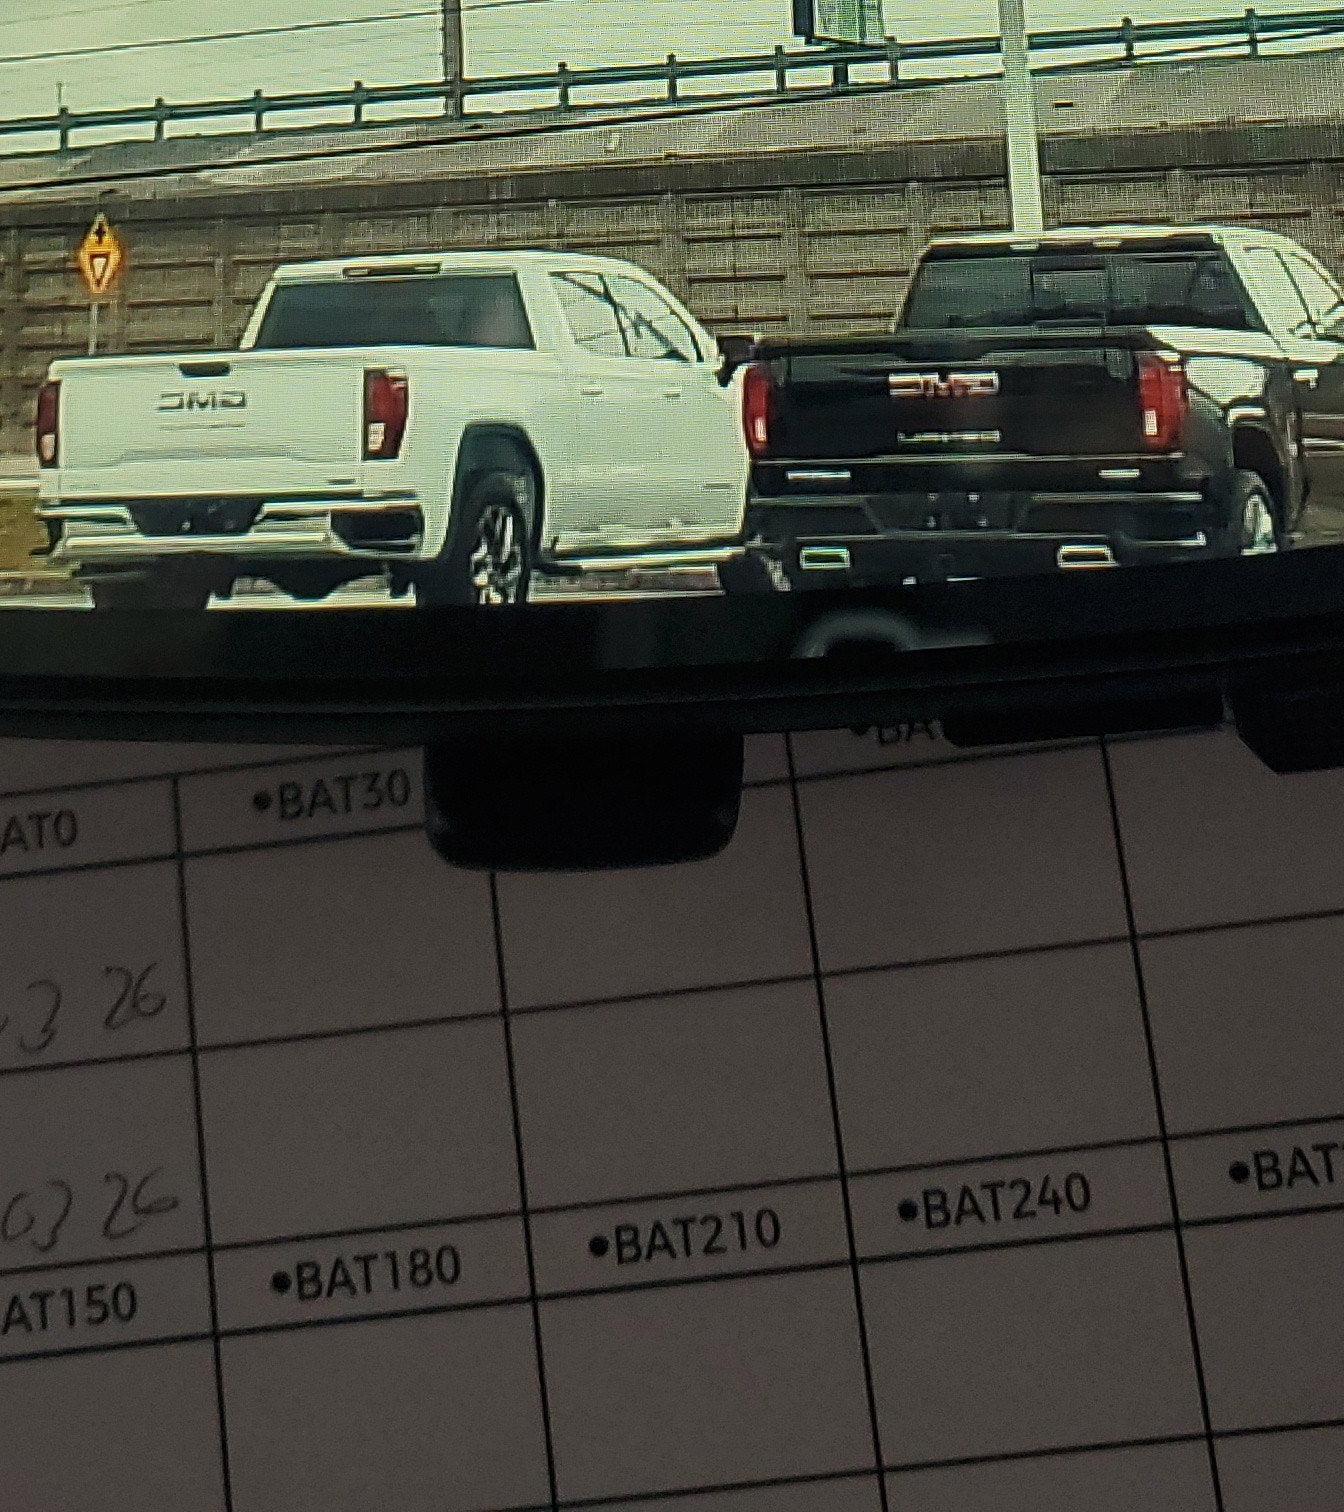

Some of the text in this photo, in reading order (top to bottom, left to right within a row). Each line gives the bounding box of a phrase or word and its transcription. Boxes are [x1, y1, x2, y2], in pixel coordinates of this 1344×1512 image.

[277, 768, 411, 821] BAT30
[105, 962, 167, 1031] 26
[103, 1165, 180, 1239] 26
[922, 1171, 1092, 1230] BAT240
[614, 1208, 782, 1265] BAT210
[294, 1244, 462, 1302] BAT180
